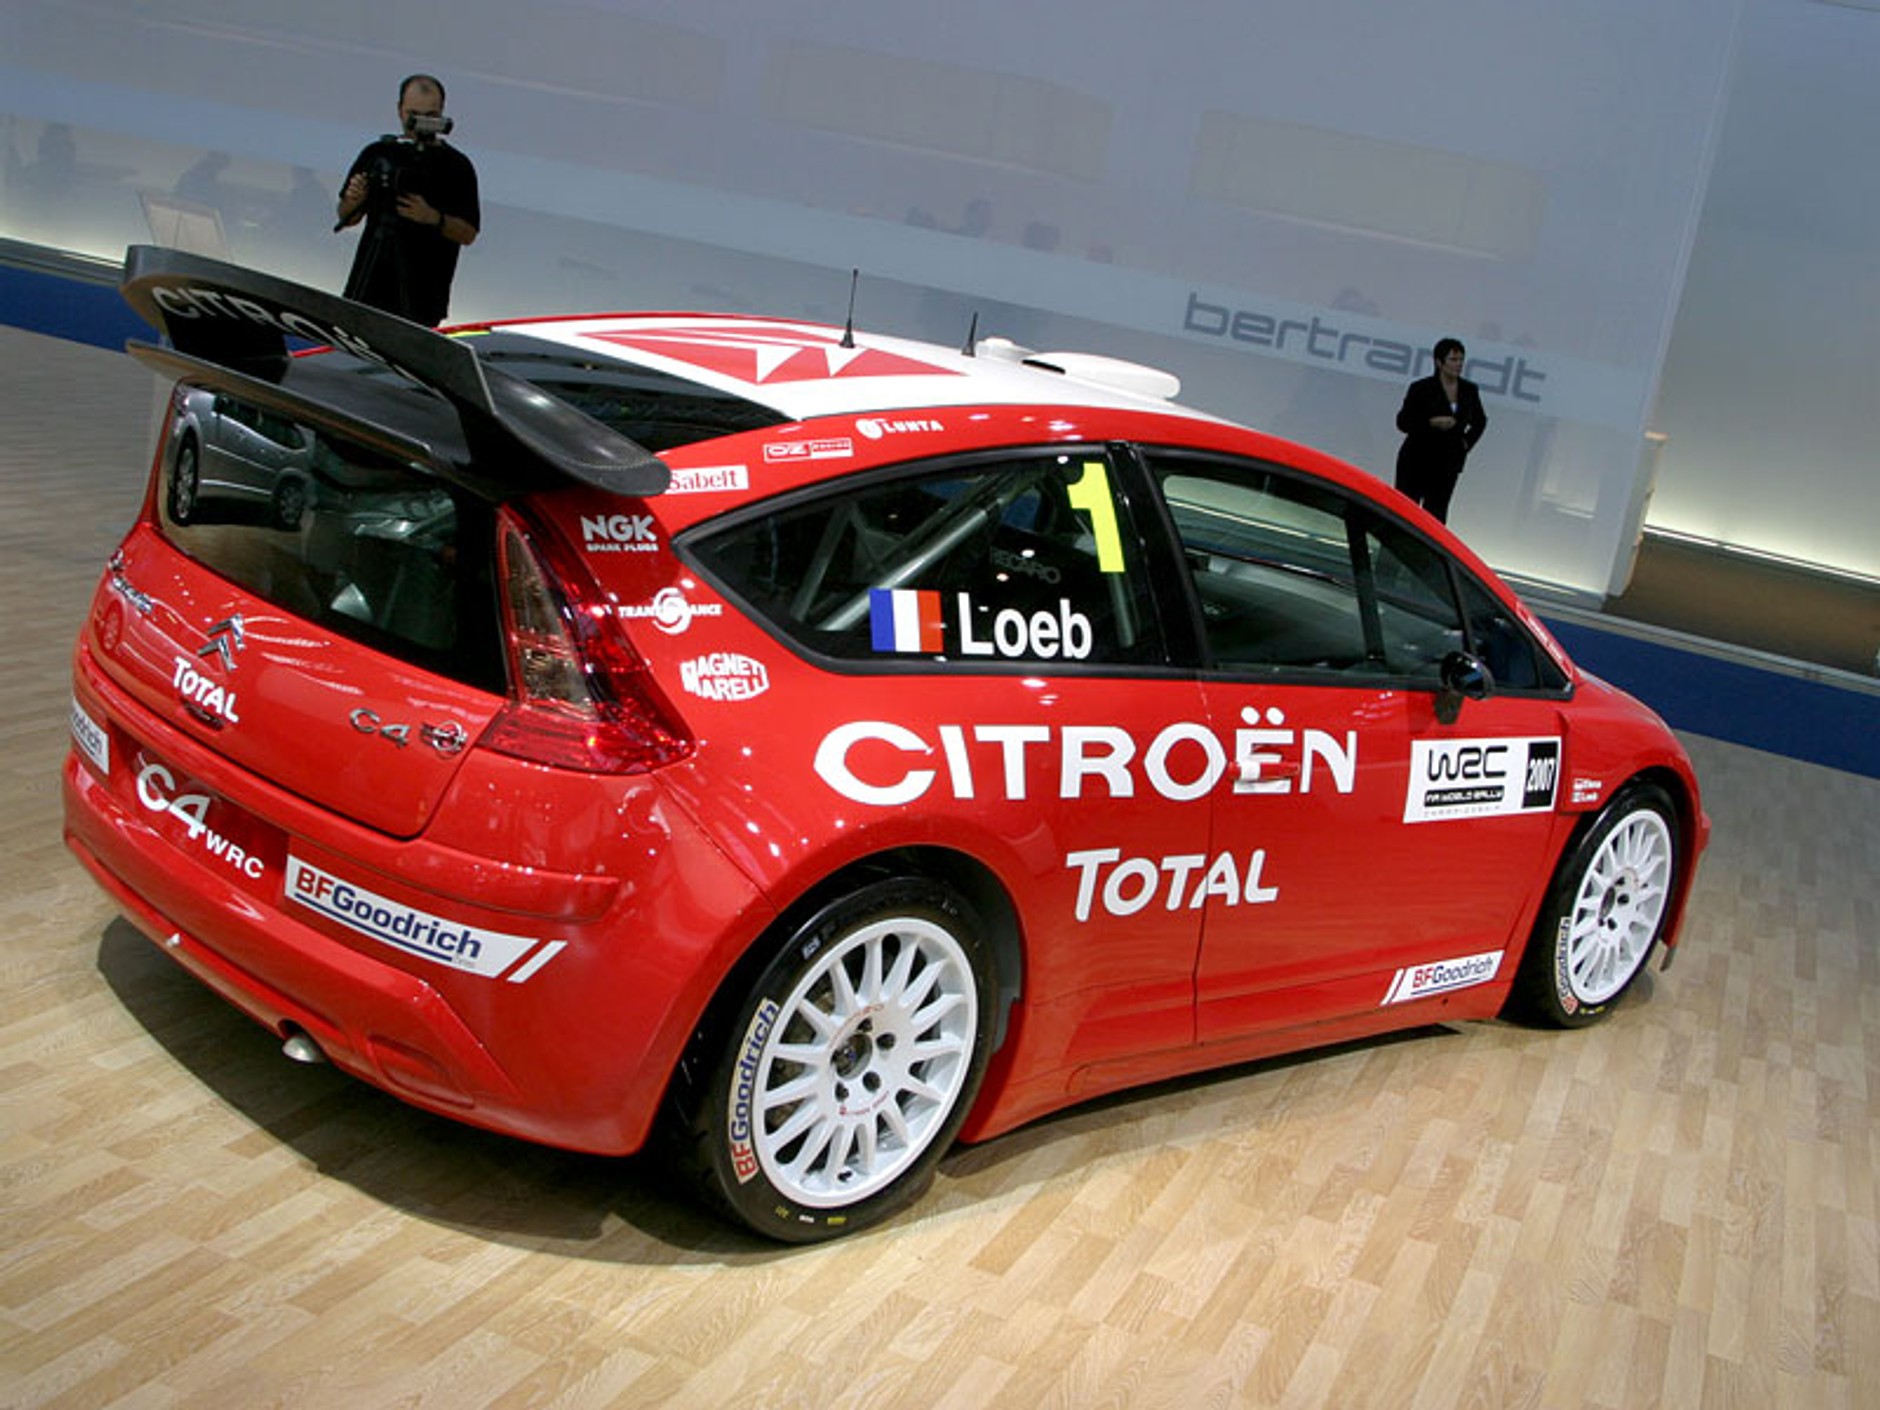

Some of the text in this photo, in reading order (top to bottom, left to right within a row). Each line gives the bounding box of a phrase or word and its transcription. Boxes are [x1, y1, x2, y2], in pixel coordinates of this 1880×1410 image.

[580, 514, 657, 542] NGK
[1067, 463, 1126, 573] 1
[957, 592, 1093, 660] Loeb
[173, 656, 240, 723] TOTAL
[350, 708, 410, 748] C4
[813, 707, 1357, 806] CITROËN
[1427, 745, 1509, 782] WRC
[1527, 757, 1556, 791] 2007
[137, 756, 264, 878] C4 WRC
[296, 866, 482, 959] BFGoodrich
[1065, 849, 1280, 923] TOTAL
[1412, 955, 1495, 989] BFGoodrich
[731, 1003, 777, 1176] BFGoodrich
